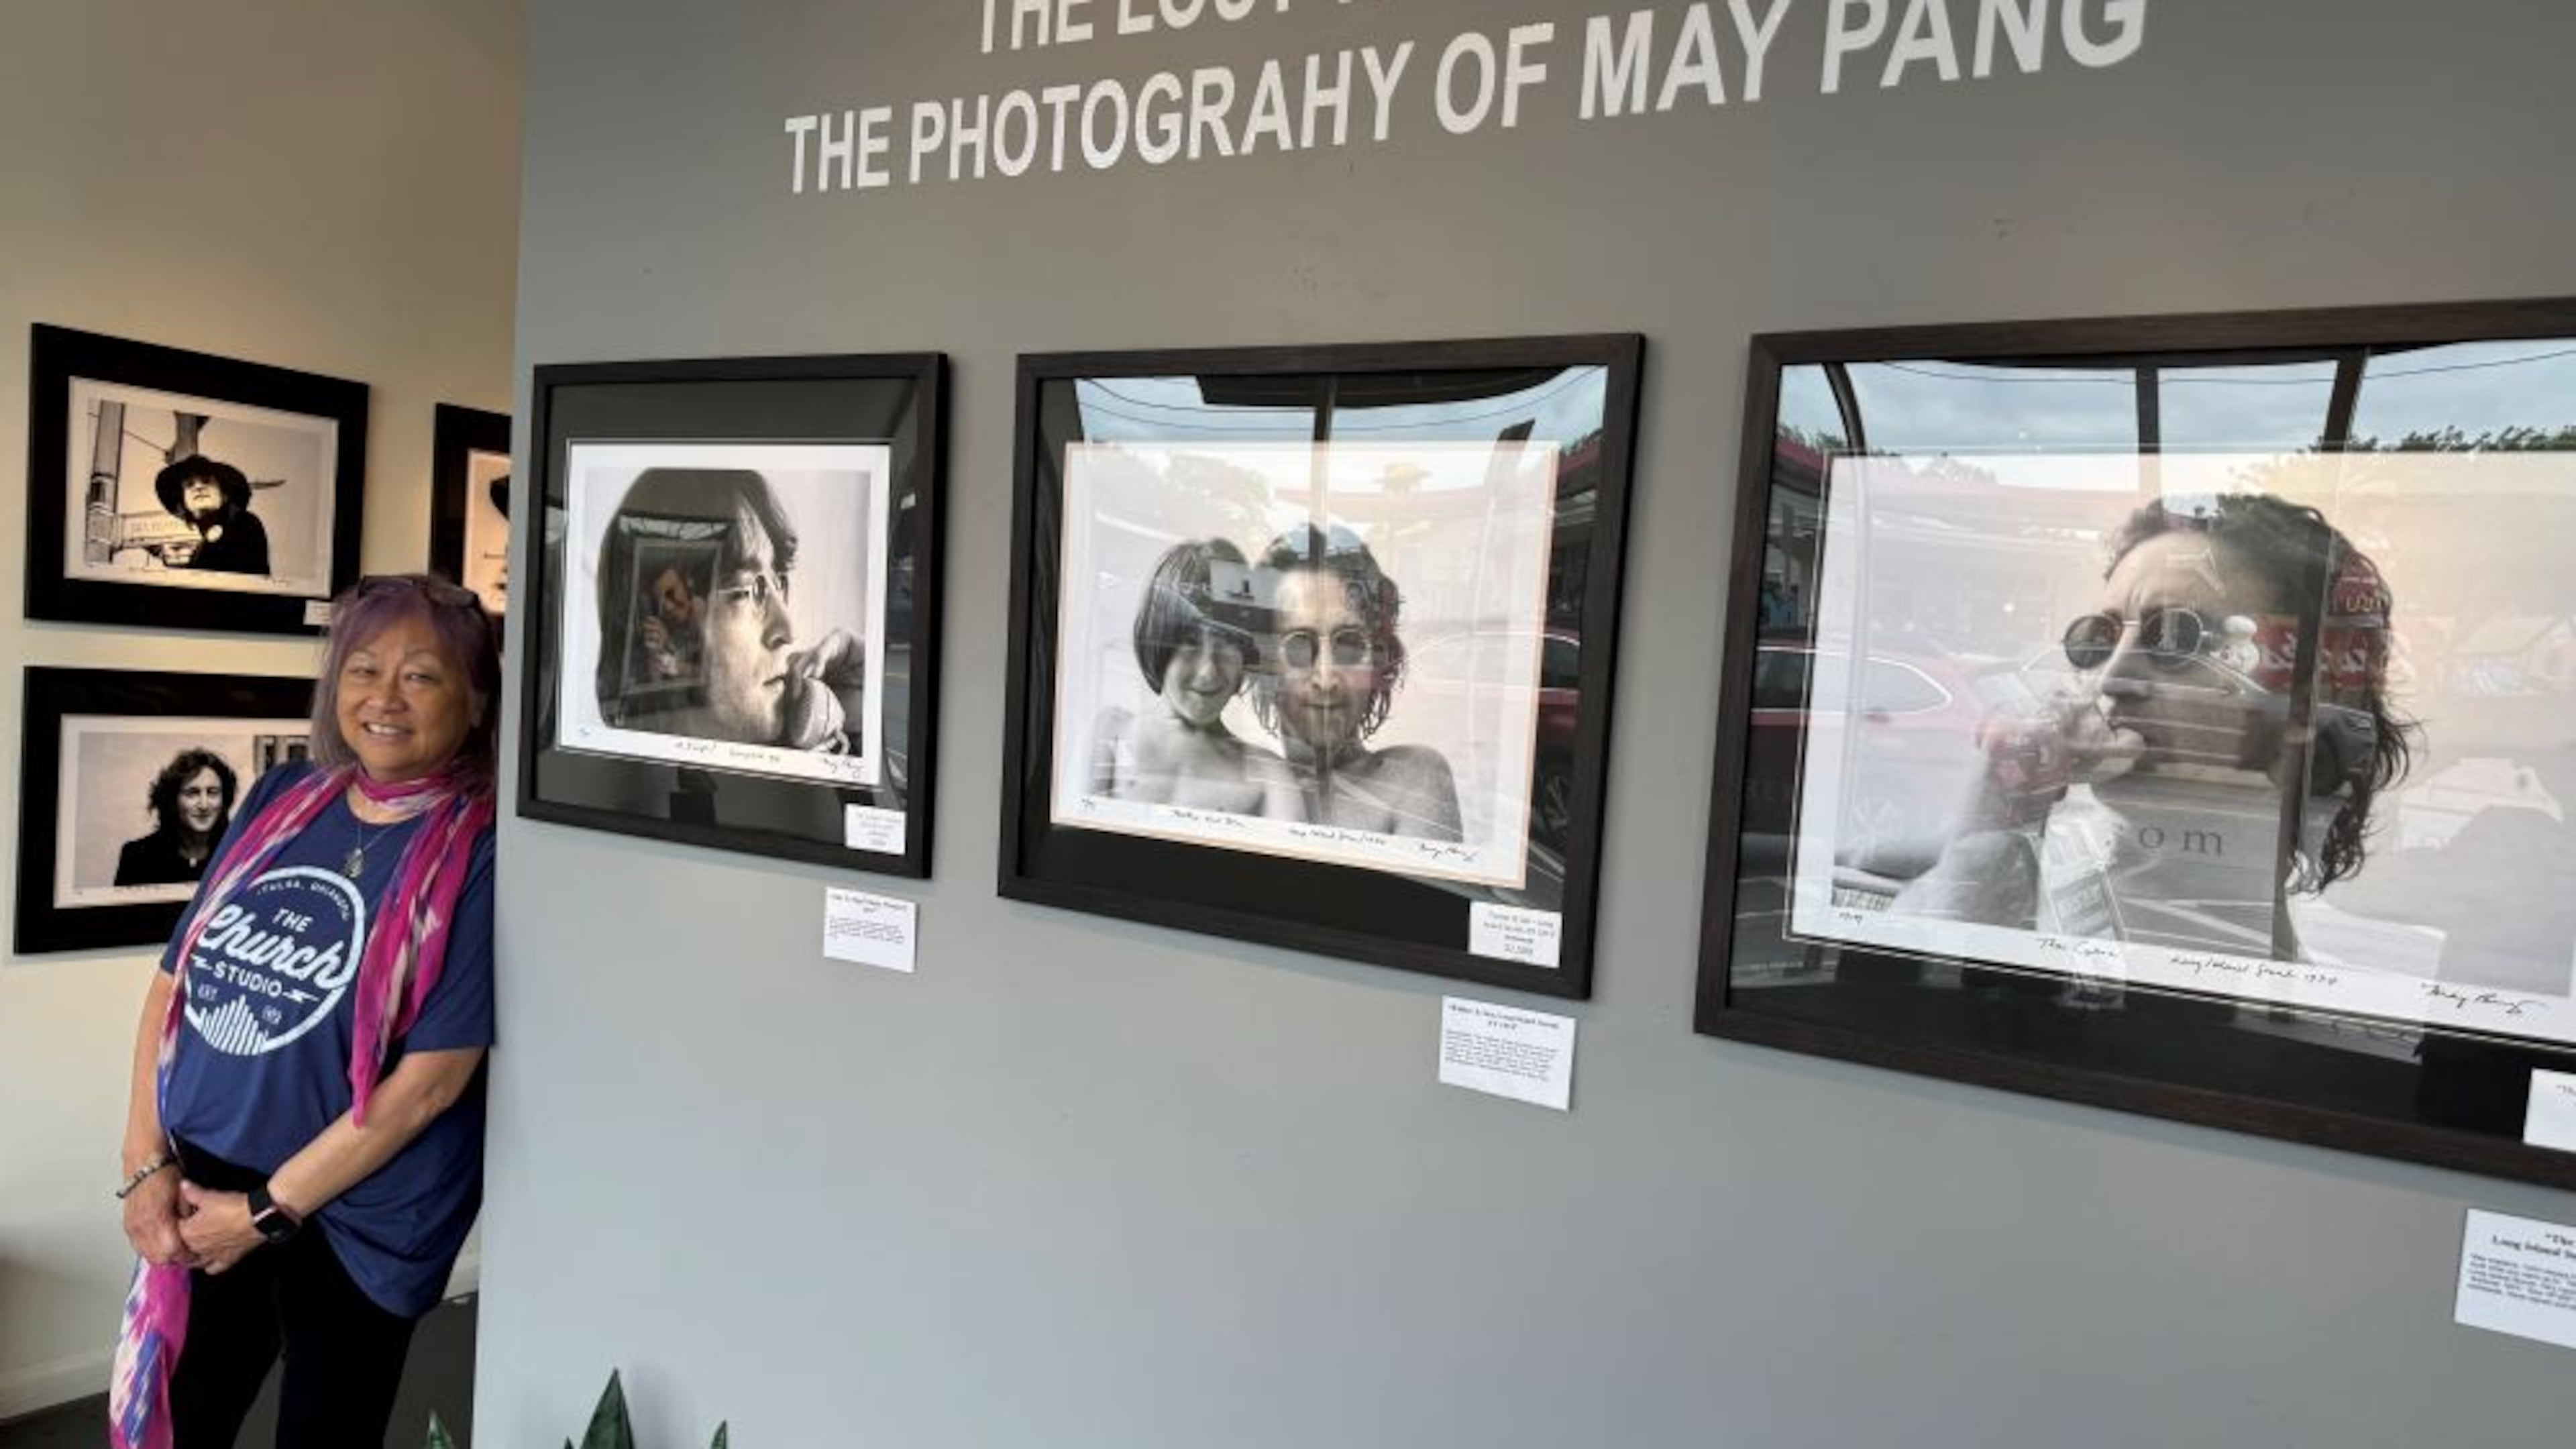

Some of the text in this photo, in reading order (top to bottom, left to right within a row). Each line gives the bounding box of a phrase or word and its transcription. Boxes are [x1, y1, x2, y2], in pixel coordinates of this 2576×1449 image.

[785, 0, 2145, 194] THE PHOTOGRAHY OF MAY PANG
[197, 904, 347, 990] Church
[272, 908, 314, 932] THE
[213, 961, 283, 998] STUDIO
